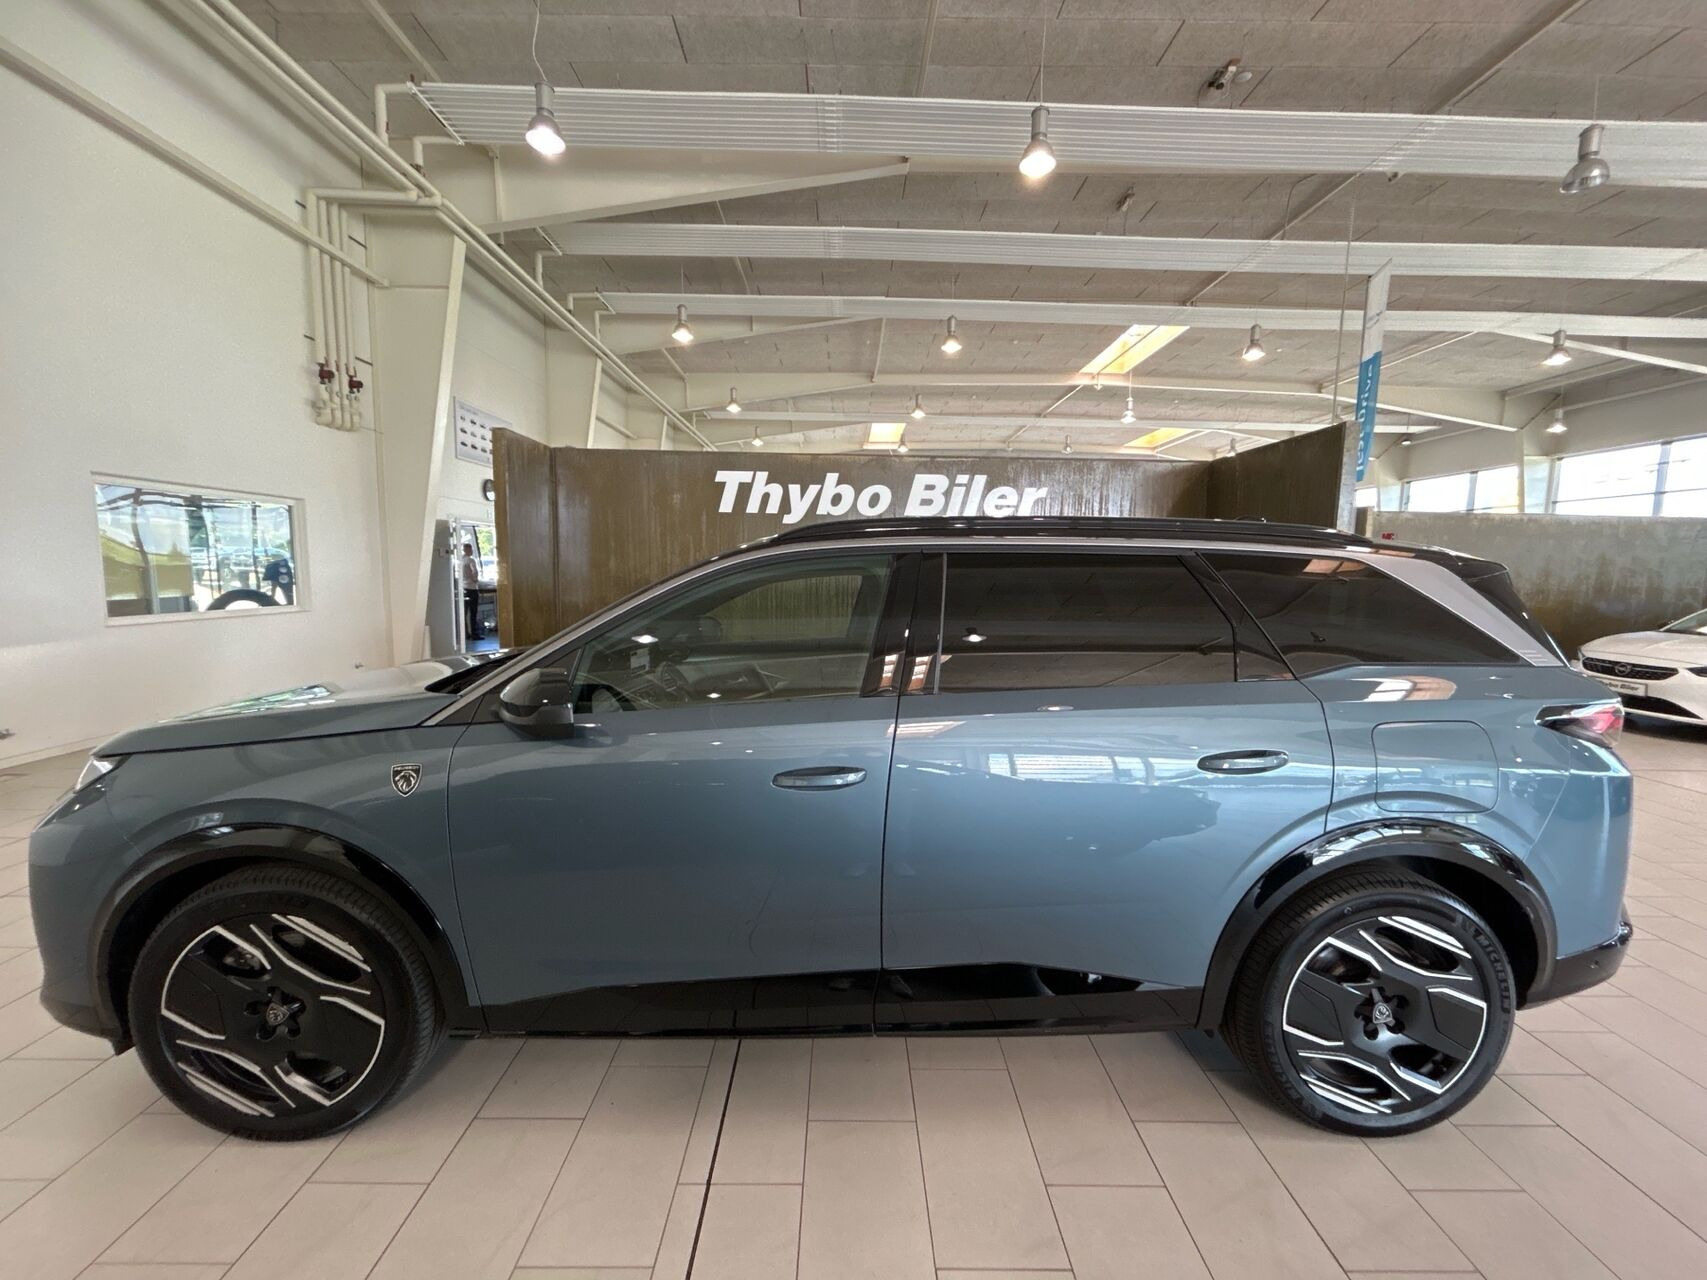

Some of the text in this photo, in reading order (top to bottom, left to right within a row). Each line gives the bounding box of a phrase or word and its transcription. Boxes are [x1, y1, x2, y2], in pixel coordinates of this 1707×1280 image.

[1358, 364, 1373, 422] Drive
[714, 470, 1047, 524] Thybo Biler
[1476, 934, 1511, 1012] MICHELIN
